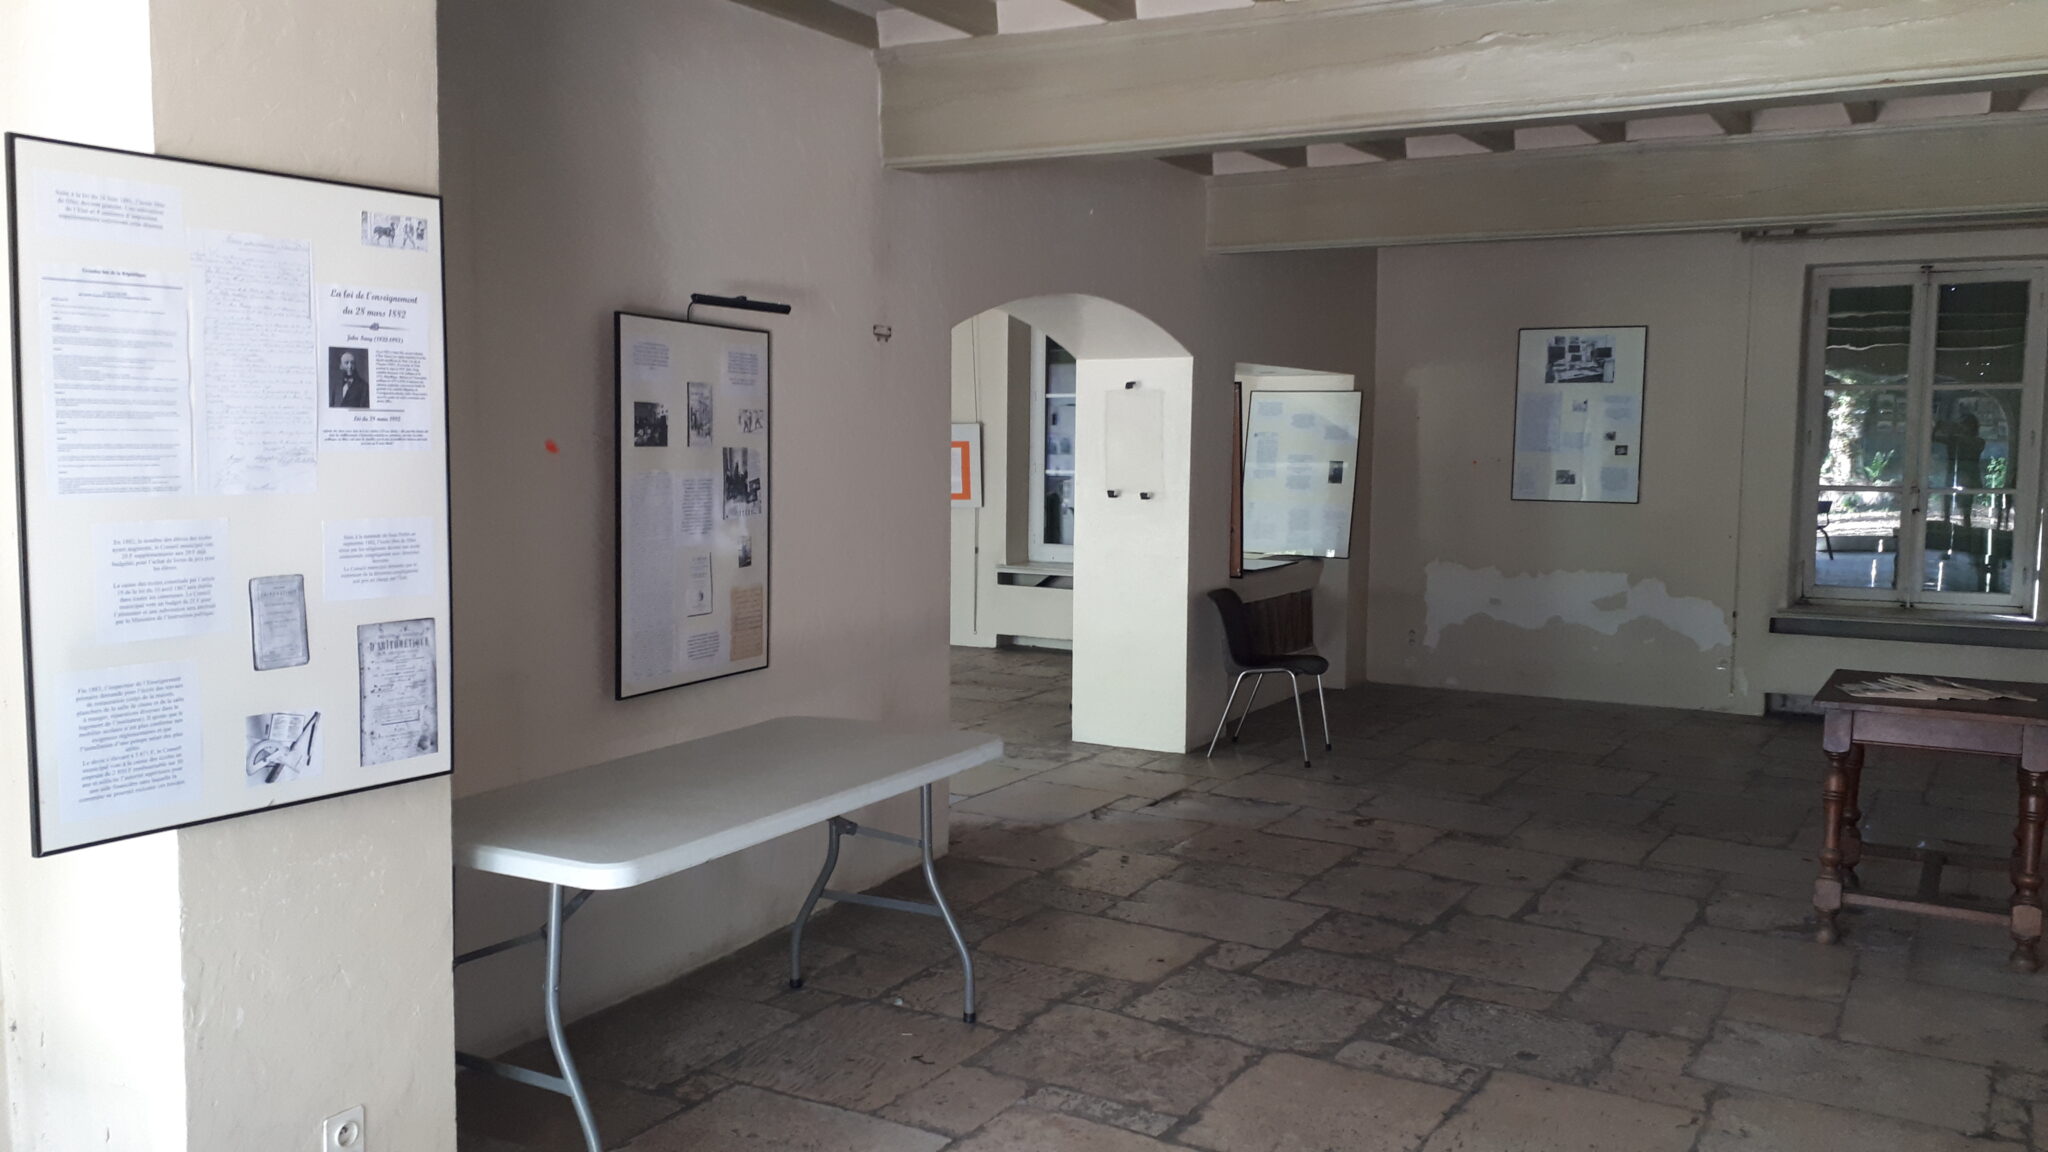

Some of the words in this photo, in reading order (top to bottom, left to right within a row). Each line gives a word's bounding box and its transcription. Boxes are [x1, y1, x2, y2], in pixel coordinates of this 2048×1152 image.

[343, 289, 353, 298] loi
[356, 290, 364, 299] de
[343, 306, 352, 315] du
